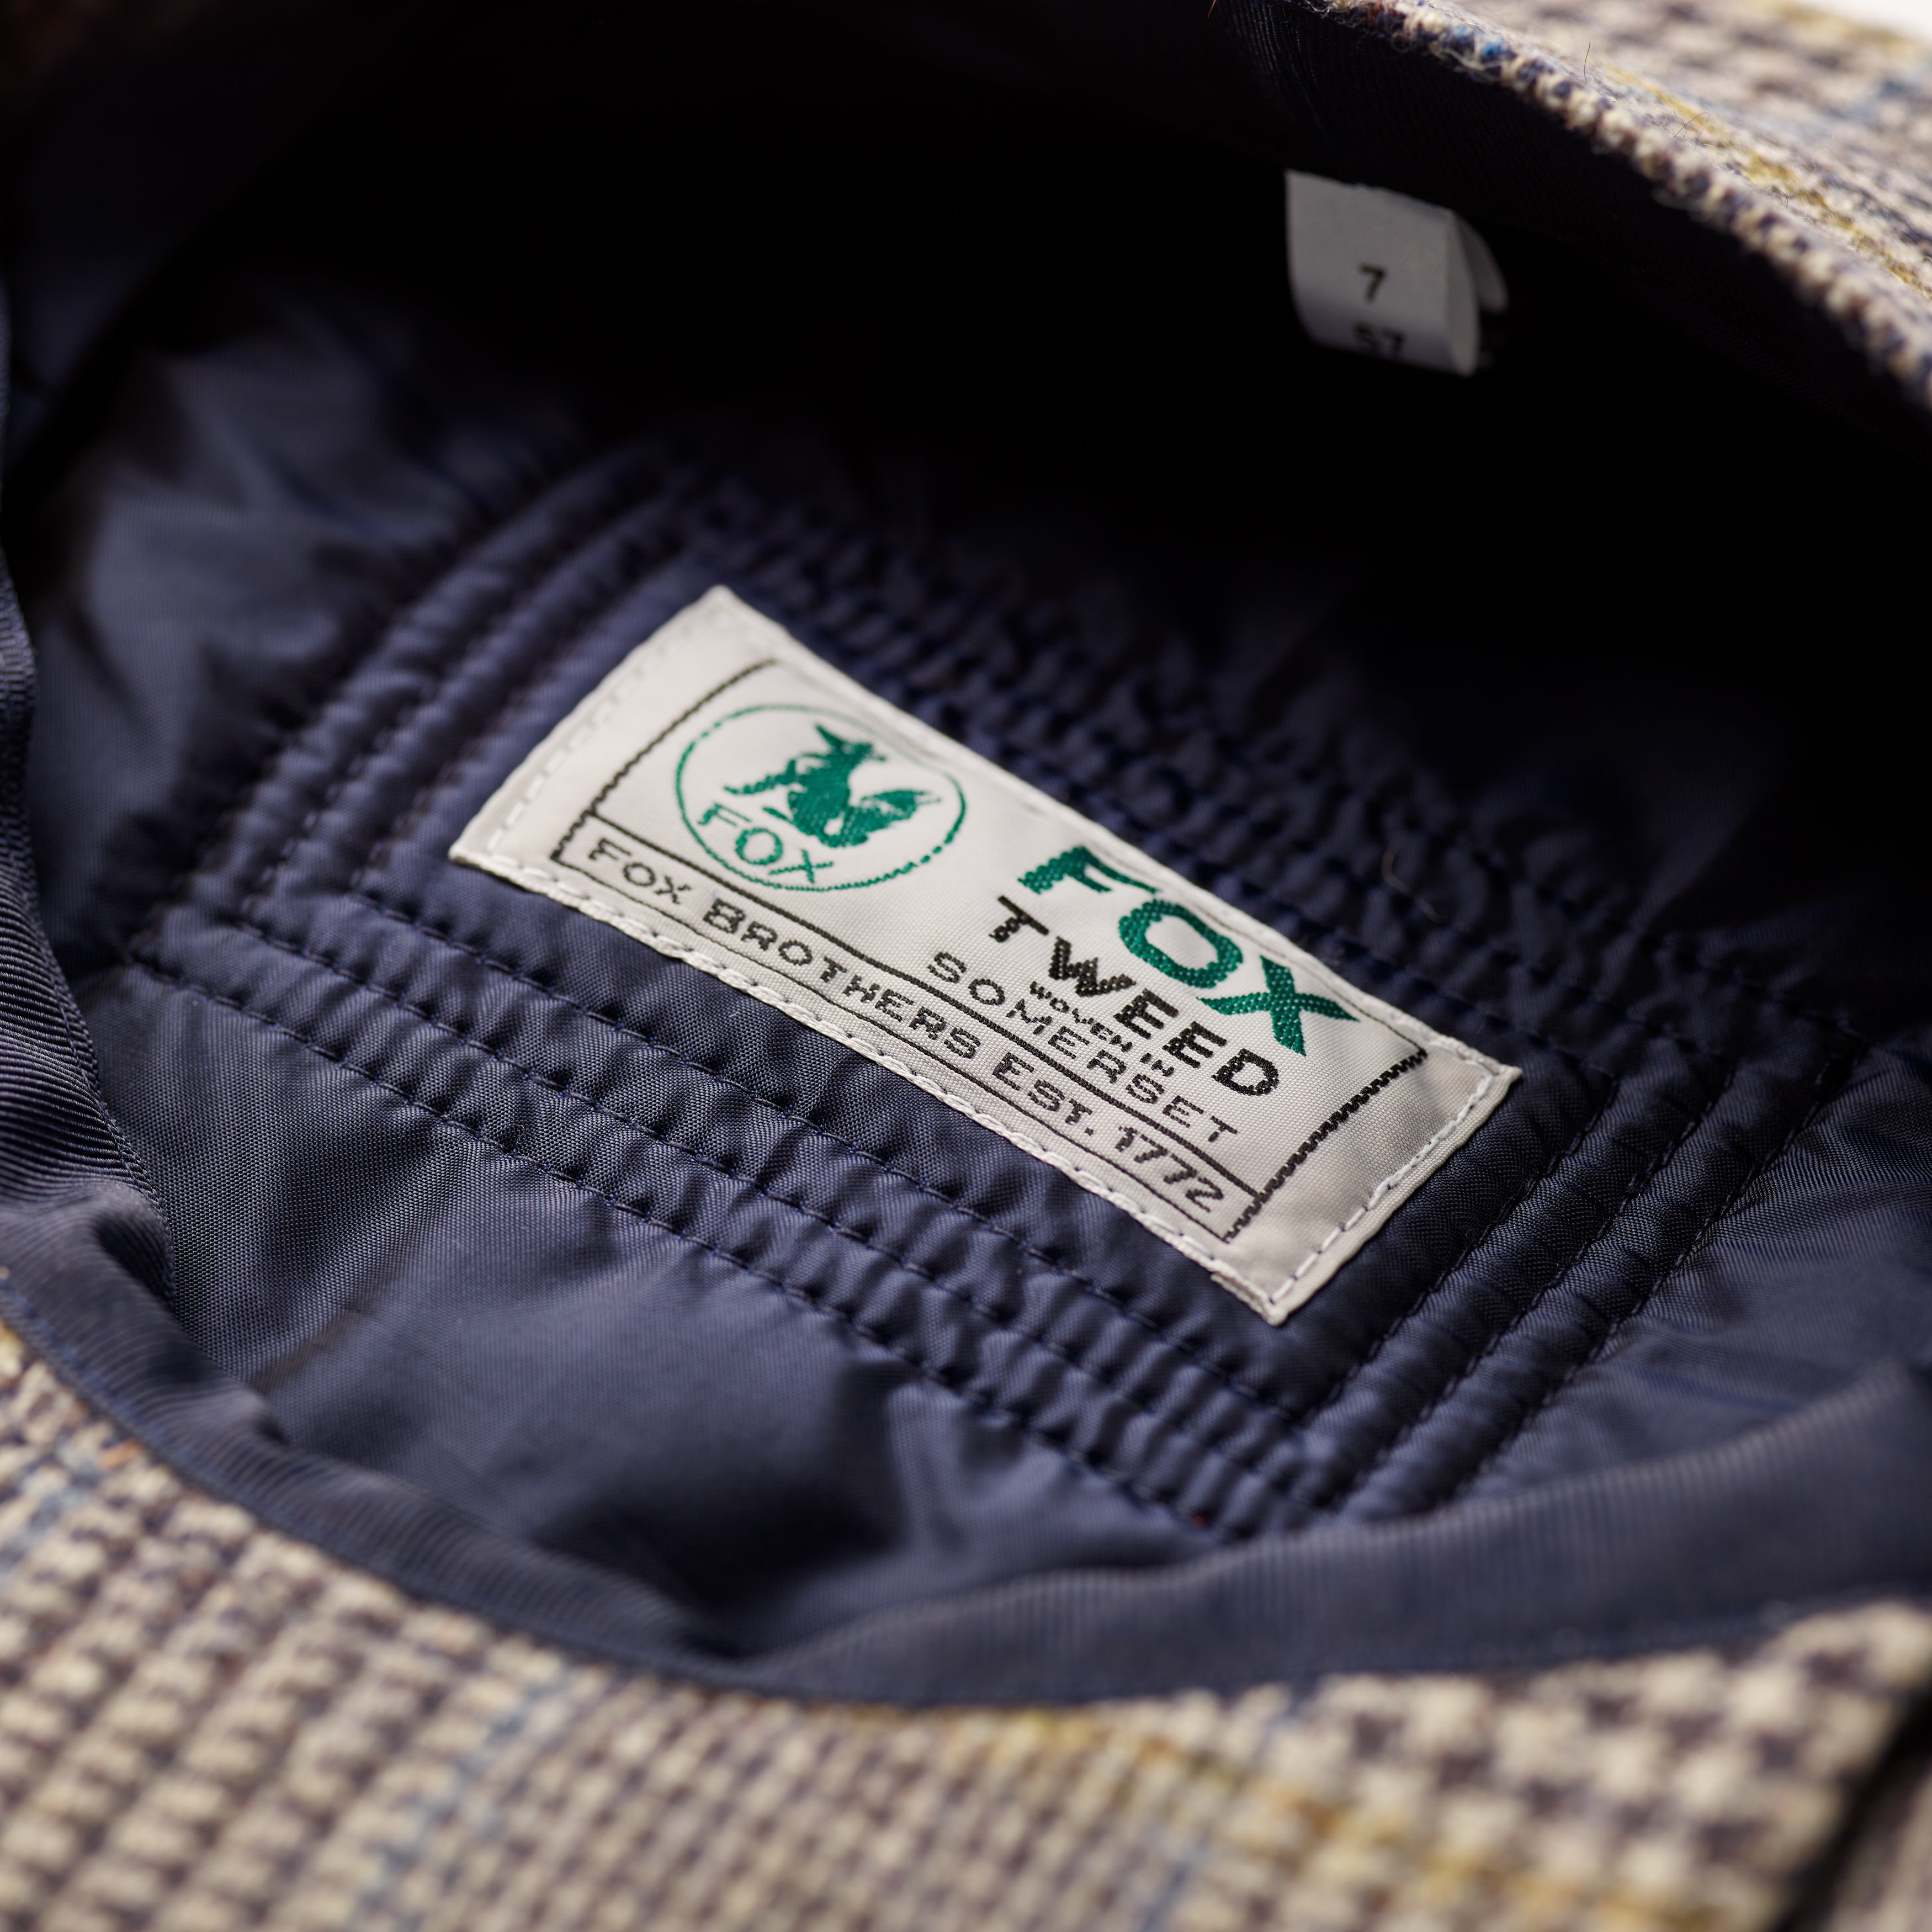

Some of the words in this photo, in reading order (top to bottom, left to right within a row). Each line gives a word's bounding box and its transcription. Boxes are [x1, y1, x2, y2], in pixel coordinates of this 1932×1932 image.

[1358, 262, 1388, 304] 7
[698, 803, 834, 883] FOX
[589, 837, 692, 904] FOX
[703, 899, 981, 1058] BROTHERS
[994, 1052, 1094, 1135] EST.
[1114, 1126, 1224, 1212] 1772
[989, 896, 1280, 1096] TWEED
[1018, 846, 1360, 1055] FOX
[1030, 981, 1133, 1052] WOVEN
[1139, 1052, 1175, 1076] IN
[927, 952, 1238, 1143] SOMERSET
